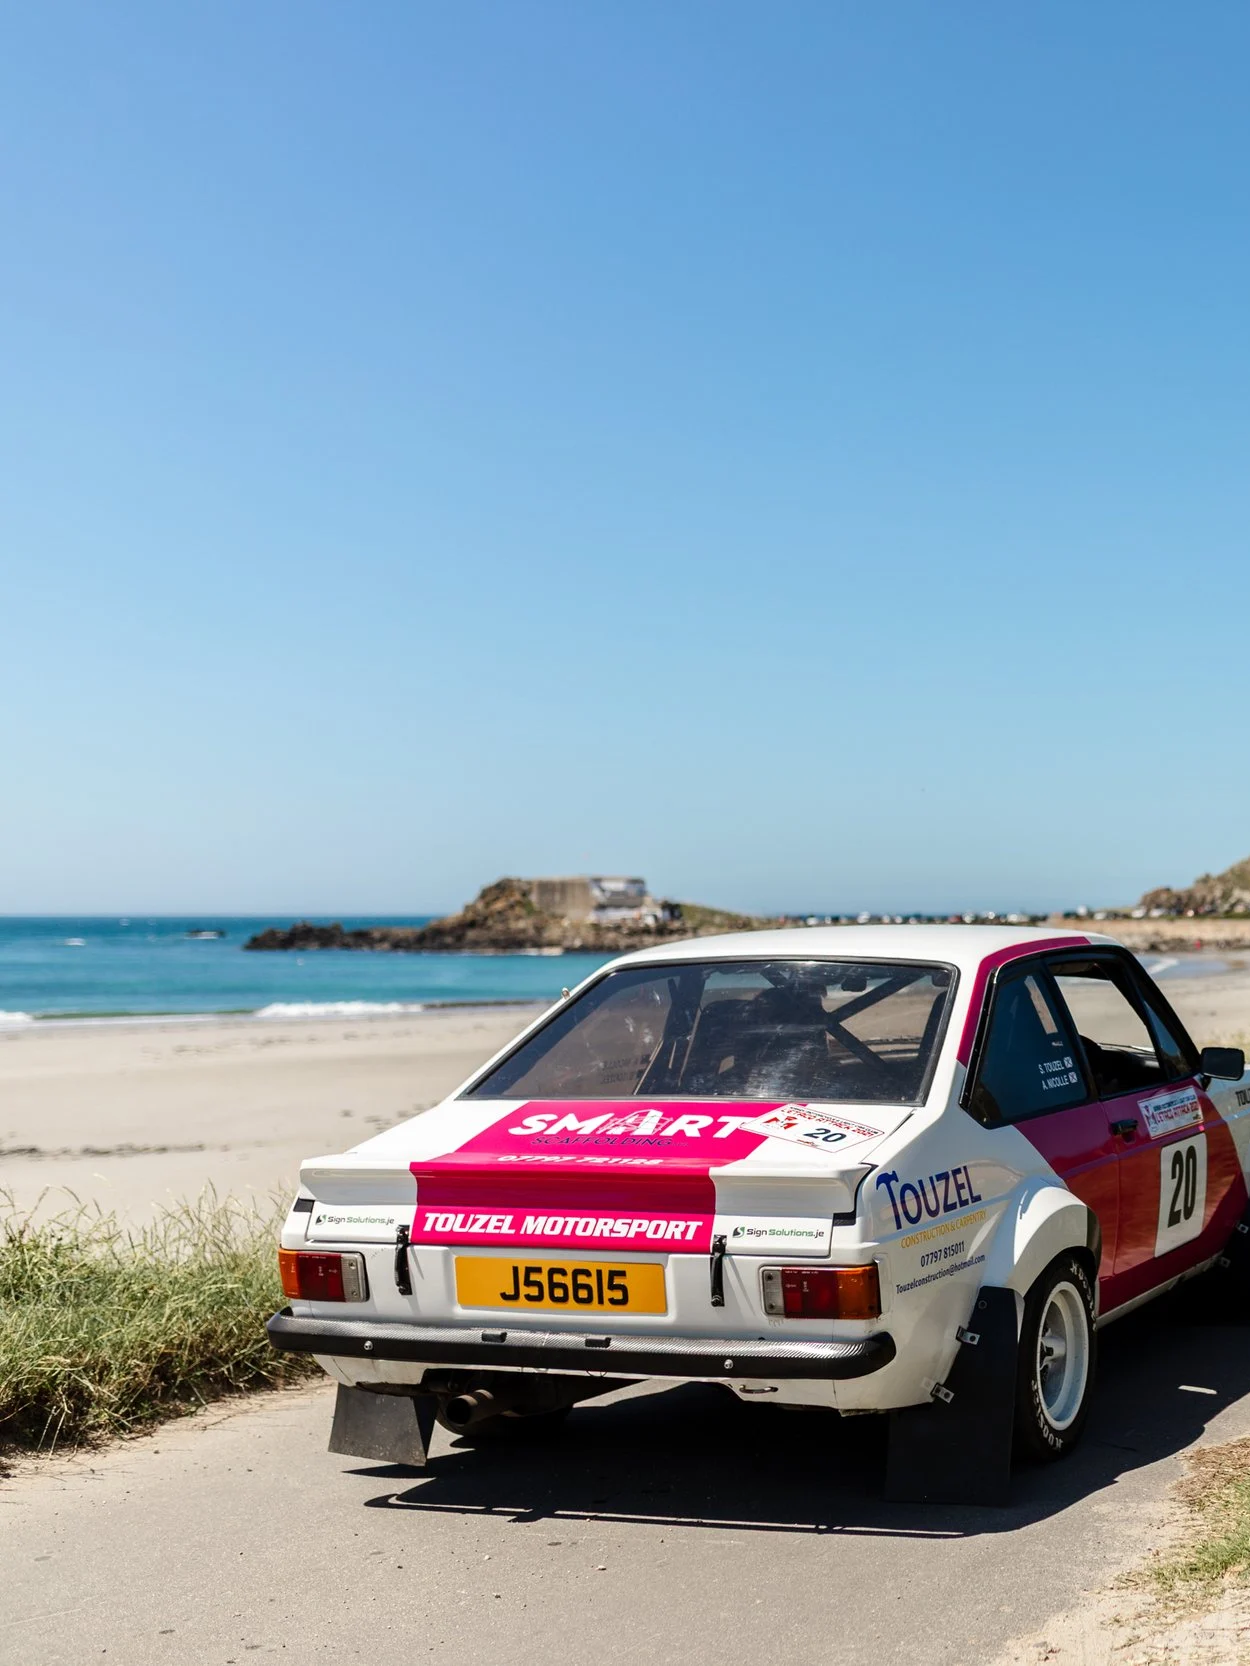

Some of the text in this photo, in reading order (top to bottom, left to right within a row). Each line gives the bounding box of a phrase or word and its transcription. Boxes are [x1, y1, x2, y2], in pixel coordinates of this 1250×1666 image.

[1043, 1060, 1065, 1073] TOUZEL
[1047, 1074, 1069, 1089] NICOLLE
[508, 1109, 759, 1139] SMART
[803, 1128, 847, 1142] 20
[531, 1136, 673, 1147] SCAFFOLDING
[497, 1155, 577, 1163] 07797
[876, 1166, 982, 1230] TOUZEL
[1167, 1145, 1197, 1228] 20
[327, 1216, 395, 1226] Sign Solutions.je
[423, 1213, 703, 1240] TOUZEL MOTORSPORT
[746, 1228, 825, 1239] Sign Solutions.je
[901, 1223, 952, 1249] CONSTRUCTION
[956, 1210, 987, 1230] CARPENTRY
[920, 1241, 965, 1267] 07797 815011
[499, 1265, 630, 1306] J56615
[896, 1254, 986, 1294] Touzelconstruction@hotmail.com
